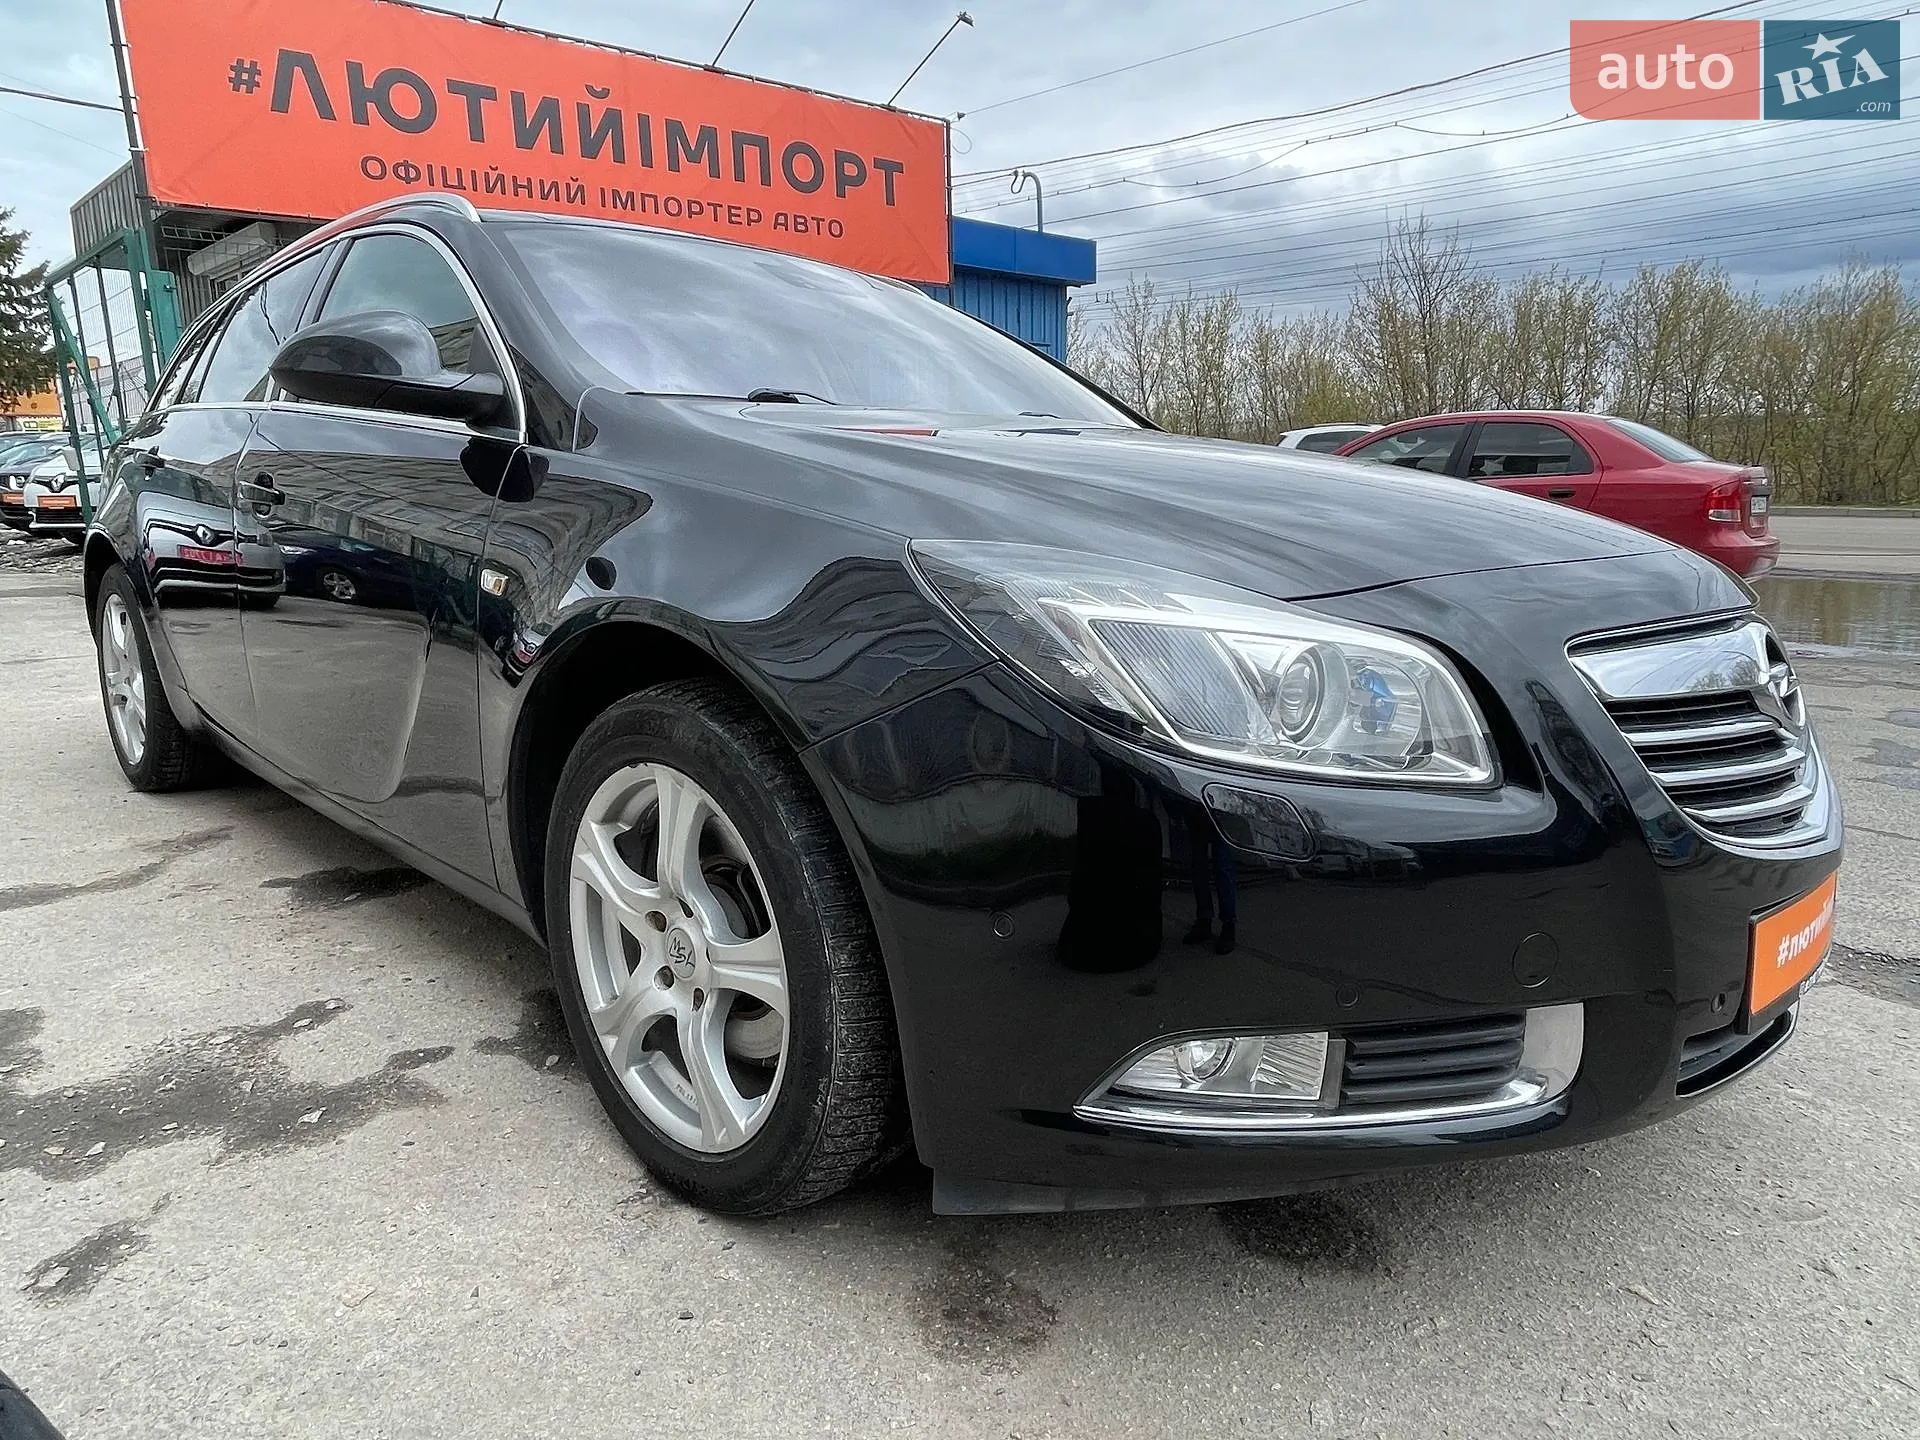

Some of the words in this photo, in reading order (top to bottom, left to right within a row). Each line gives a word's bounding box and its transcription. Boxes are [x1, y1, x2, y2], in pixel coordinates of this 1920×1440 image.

[227, 48, 905, 207] #ЛЮТИЙІМПОРТ
[360, 155, 587, 206] ОФІЦІЙНИЙ
[599, 186, 763, 227] ІМПОРТЕР
[772, 212, 845, 239] АВТО
